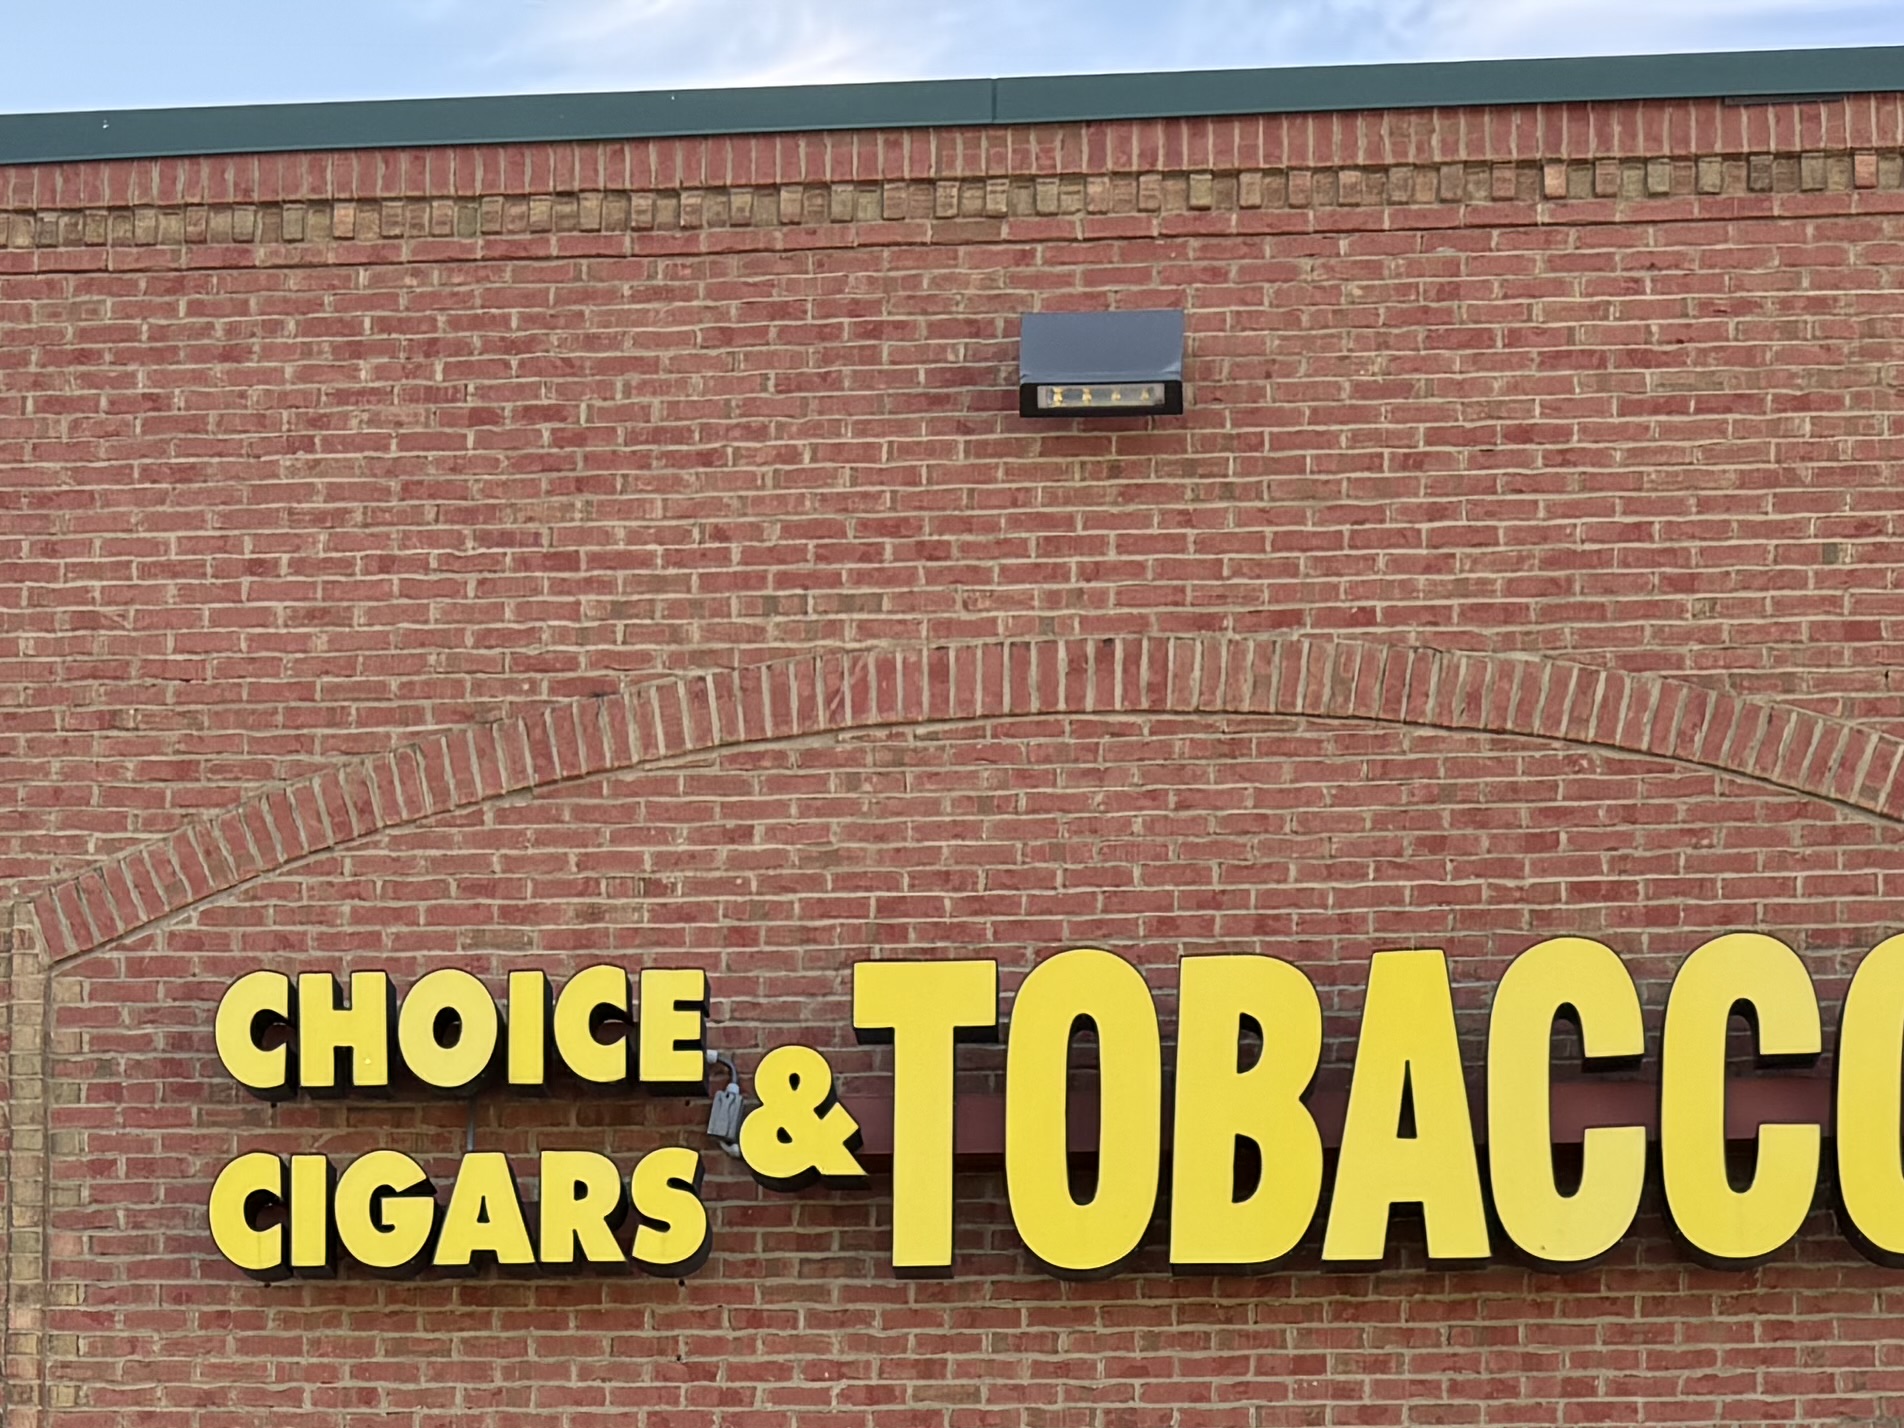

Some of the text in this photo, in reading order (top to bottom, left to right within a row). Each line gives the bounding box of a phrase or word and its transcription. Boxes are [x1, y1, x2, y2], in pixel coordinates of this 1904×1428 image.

[213, 963, 709, 1092] CHOICE
[738, 1044, 870, 1180] &
[207, 1146, 710, 1272] CIGARS
